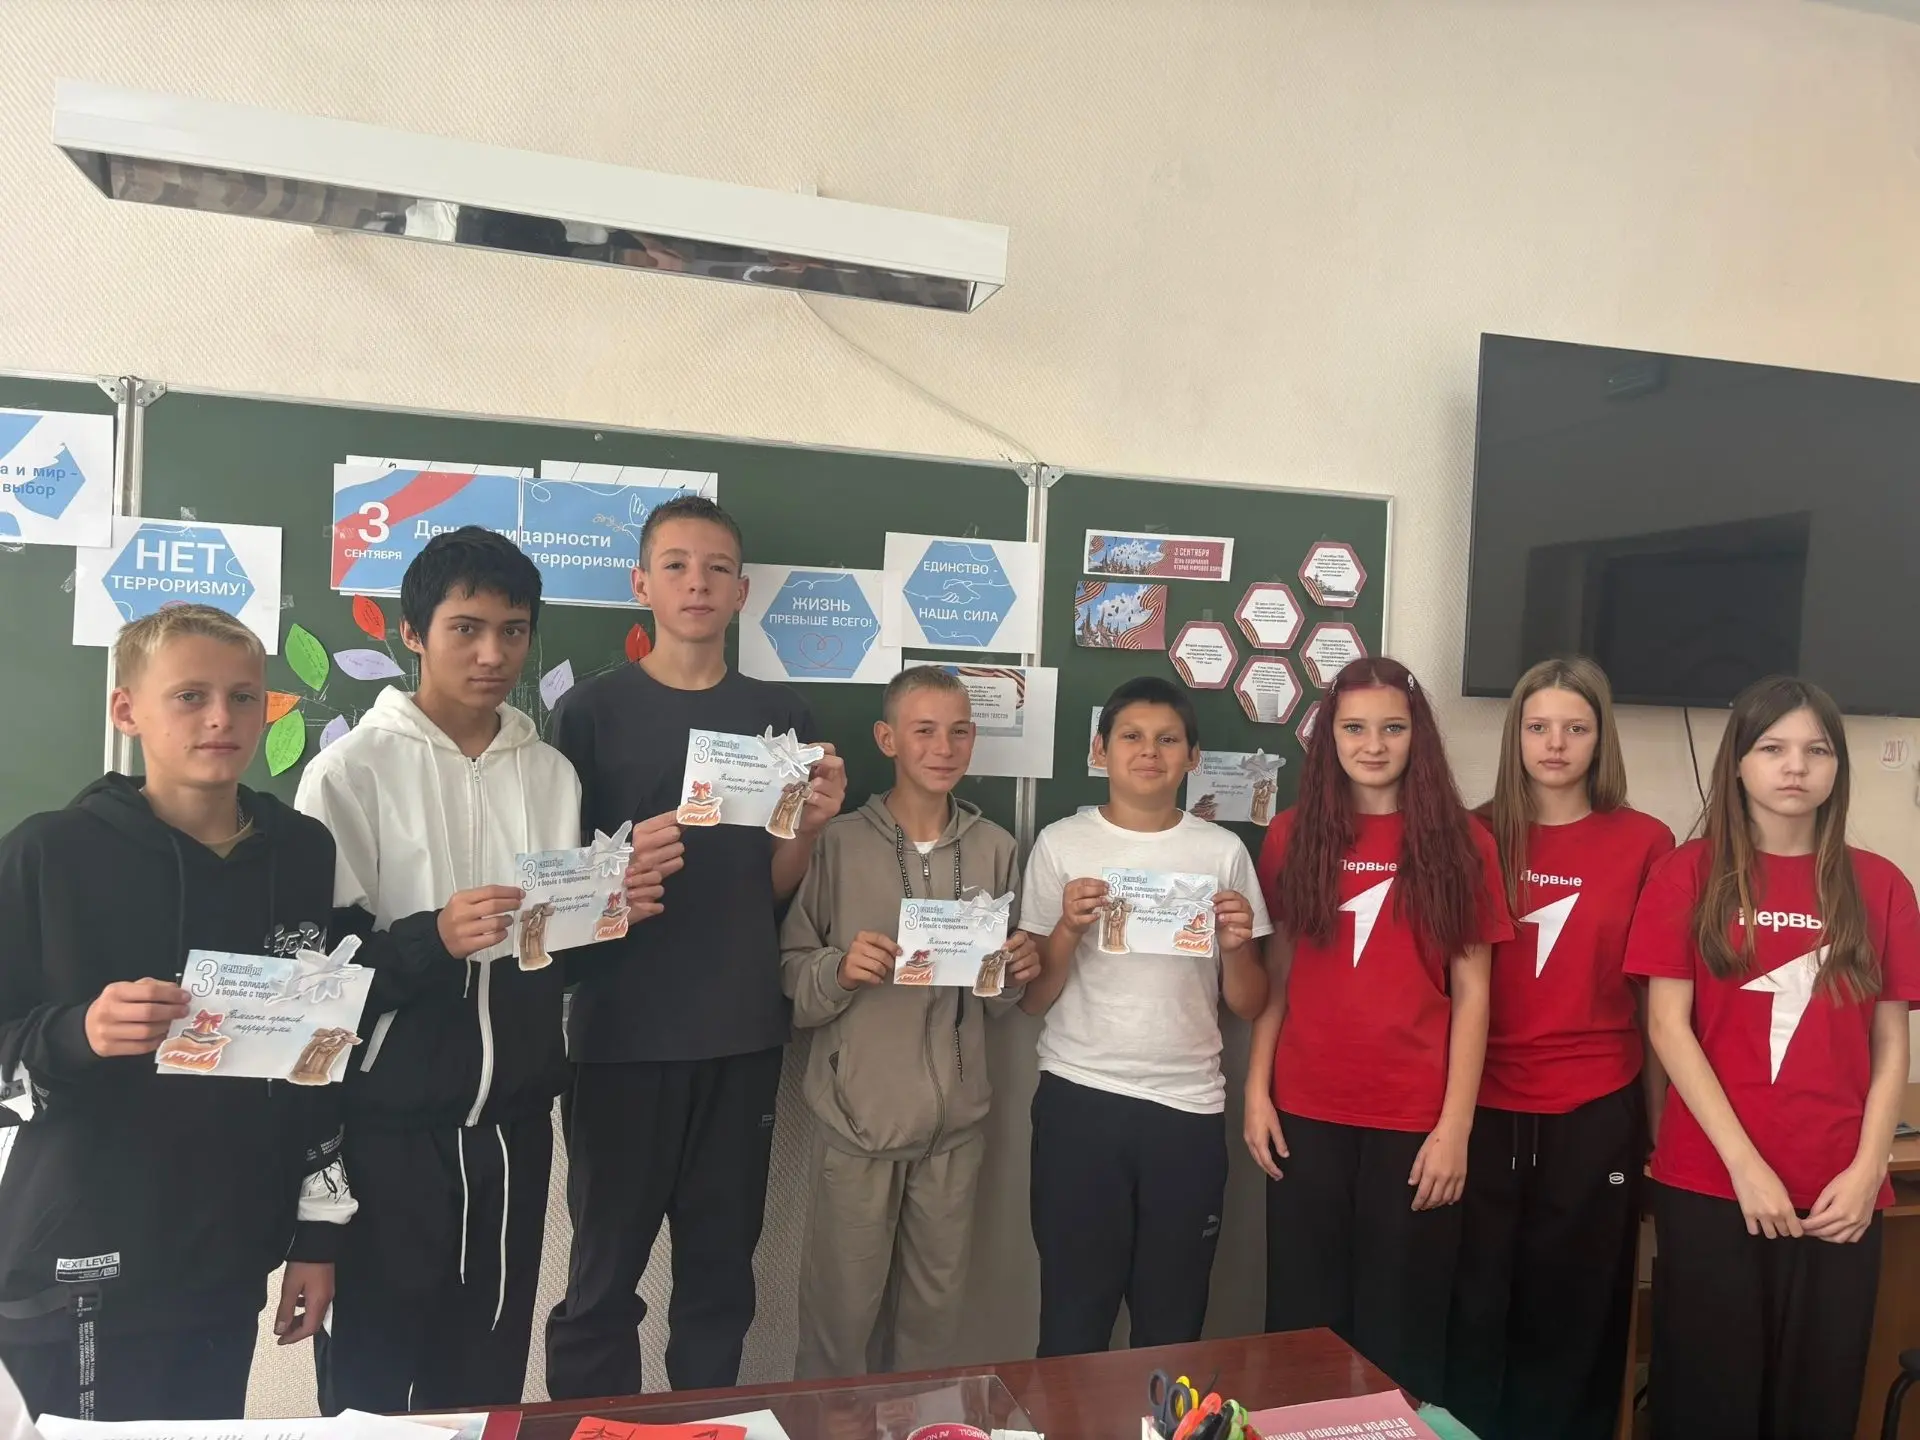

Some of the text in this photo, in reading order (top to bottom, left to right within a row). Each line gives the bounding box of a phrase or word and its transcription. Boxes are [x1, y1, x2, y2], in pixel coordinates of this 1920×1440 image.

[16, 466, 25, 476] и
[33, 467, 65, 479] мир
[2, 483, 55, 498] выбор
[358, 501, 390, 543] 3
[414, 519, 460, 539] Ден
[136, 539, 226, 575] НЕТ
[344, 548, 402, 561] СЕНТЯБРЯ
[1180, 547, 1210, 557] СЕНТЯБРЯ
[923, 560, 989, 575] ЕДИНСТВО
[111, 575, 246, 596] ТЕРРОРИЗМУ!
[792, 597, 851, 613] ЖИЗНЬ
[769, 613, 873, 628] ПРЕВЫШЕ ВСЕГО!
[919, 607, 999, 623] НАША СИЛА
[694, 736, 710, 764] 3
[522, 859, 537, 891] 3
[1107, 873, 1121, 899] 3
[905, 903, 920, 930] 3
[192, 959, 262, 998] 3 сентября
[218, 977, 270, 990] День солидар
[215, 988, 220, 996] в
[222, 987, 247, 997] борьбе
[86, 1255, 117, 1266] LEVEL
[1308, 1423, 1363, 1438] МИРОВОЙ
[1363, 1417, 1409, 1432] ВТОРОЙ
